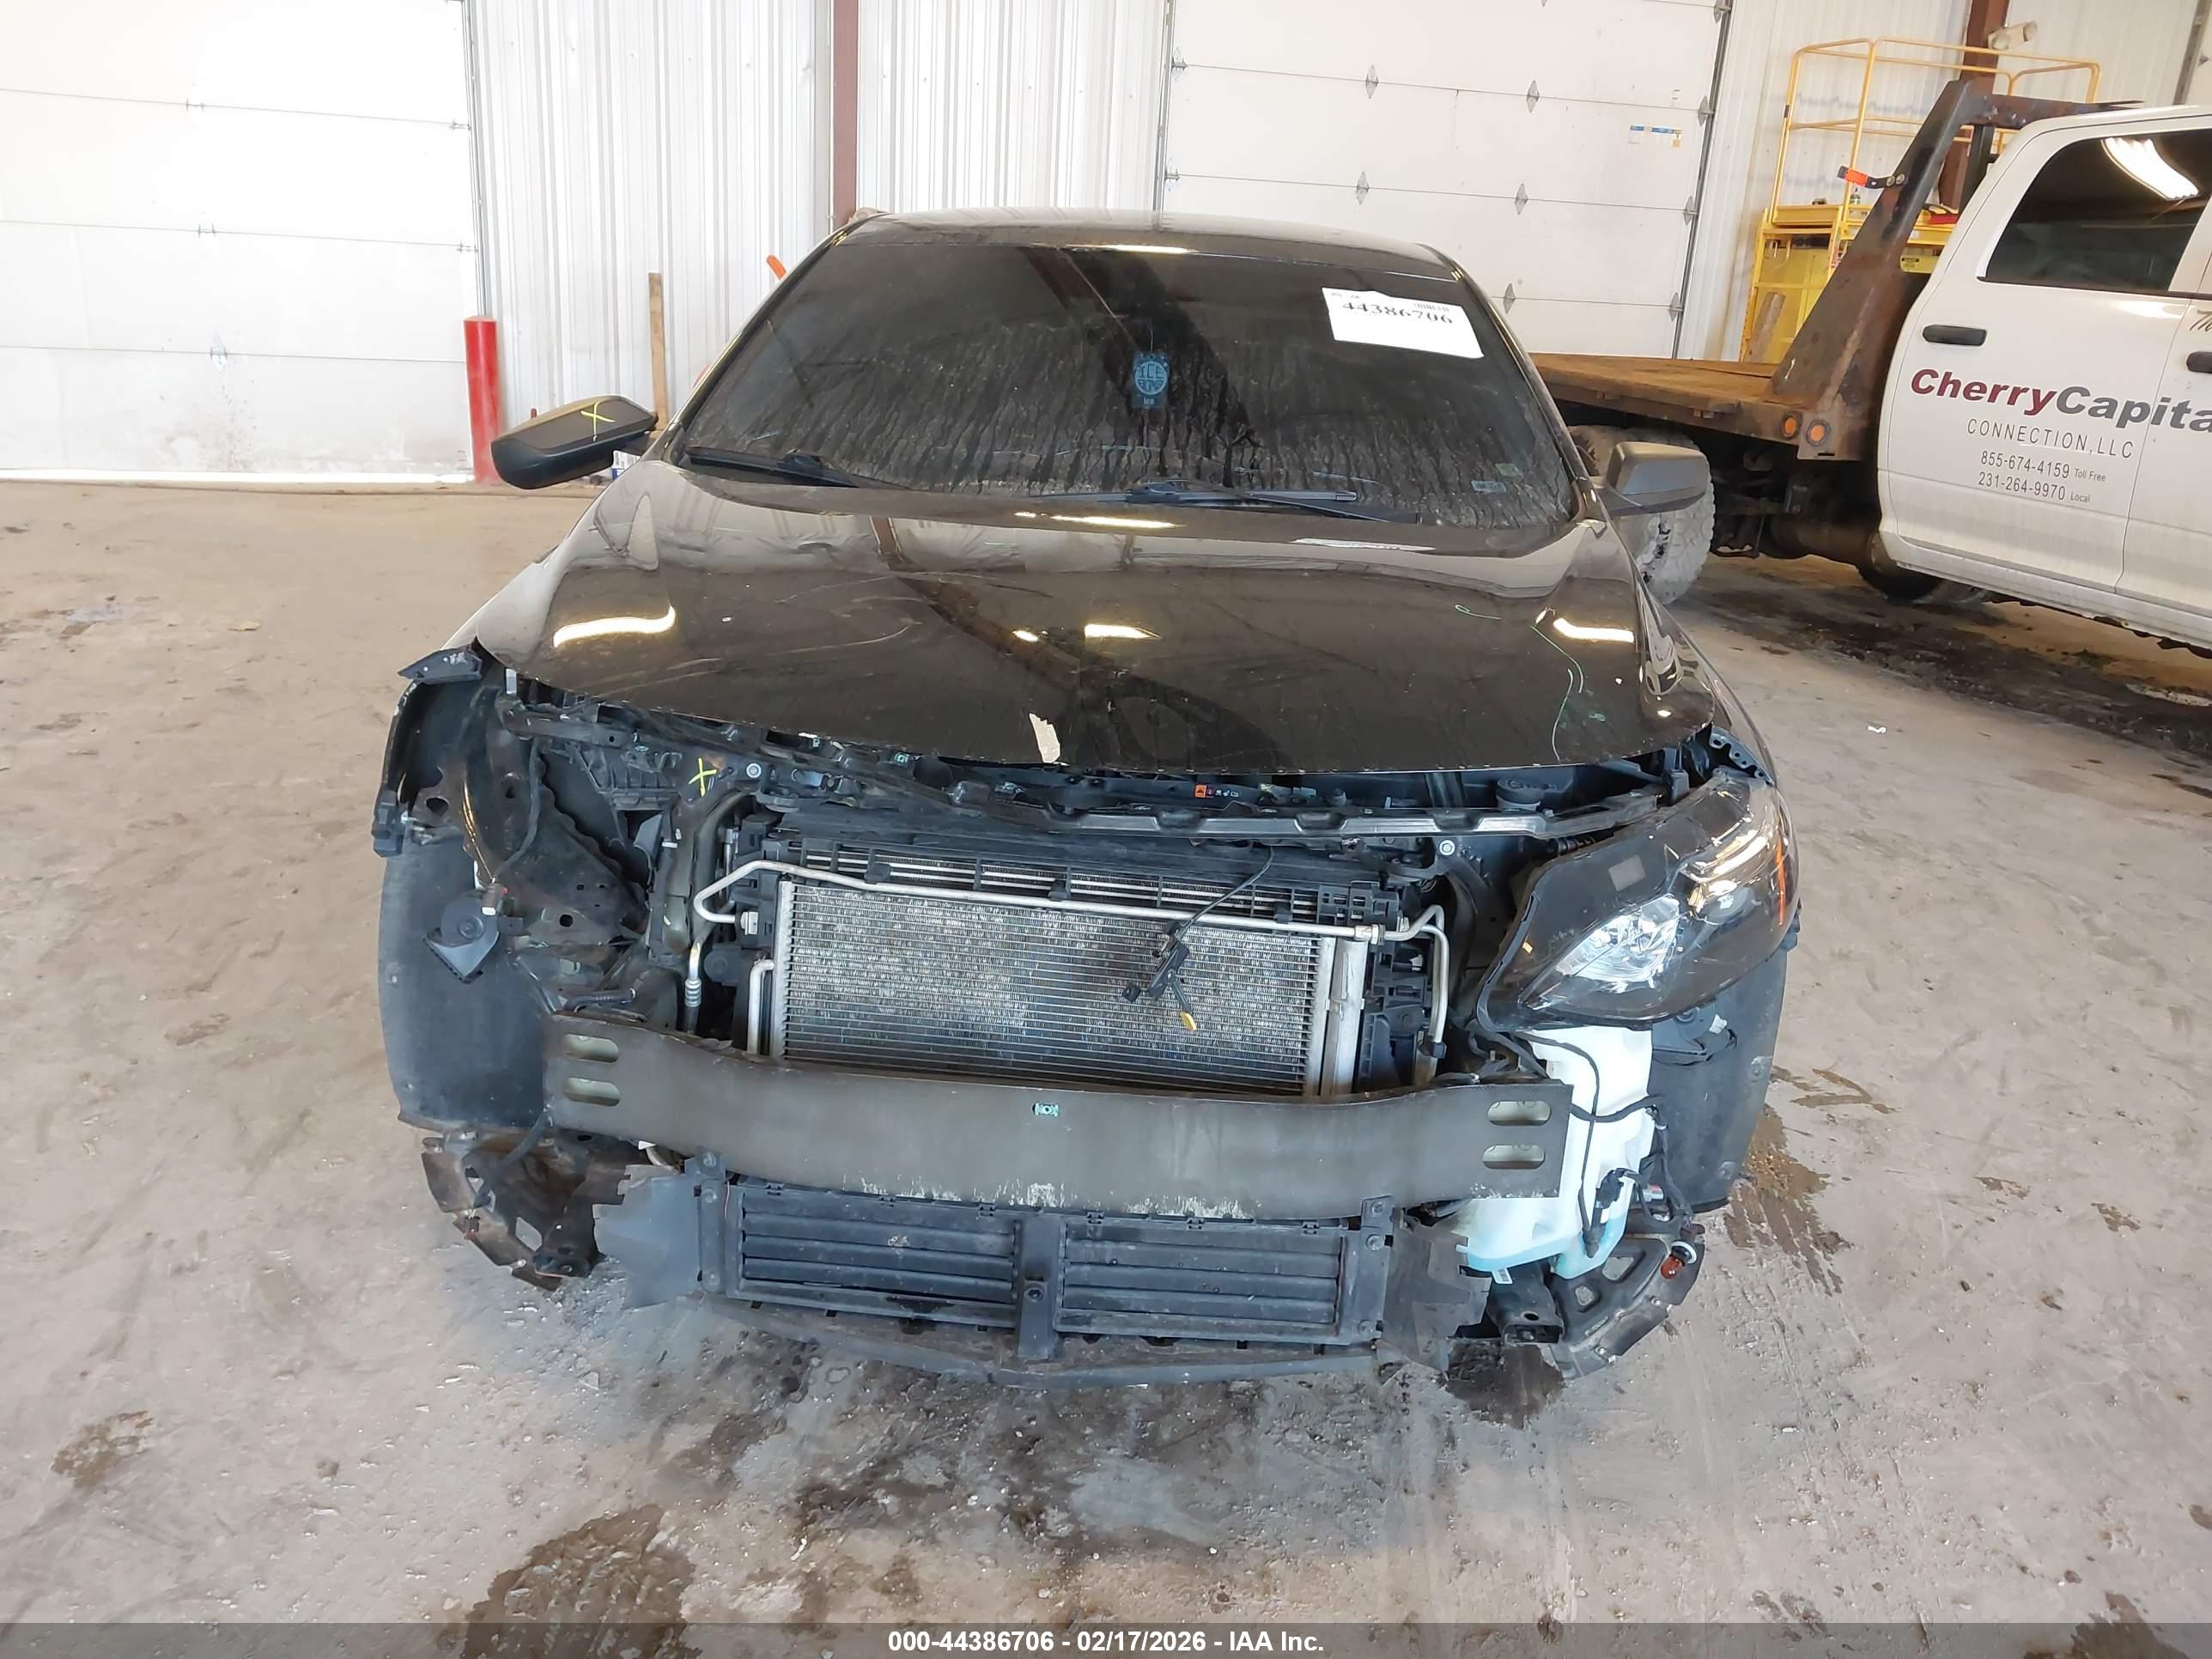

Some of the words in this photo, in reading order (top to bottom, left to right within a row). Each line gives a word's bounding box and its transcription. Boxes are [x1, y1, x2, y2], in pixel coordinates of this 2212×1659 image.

[1342, 302, 1453, 323] 44386706
[1980, 450, 2069, 479] 855-674-4159
[2075, 468, 2087, 479] Toll
[2089, 471, 2106, 483] Free
[1978, 471, 2065, 501] 231-264-9970
[2070, 492, 2090, 502] Local
